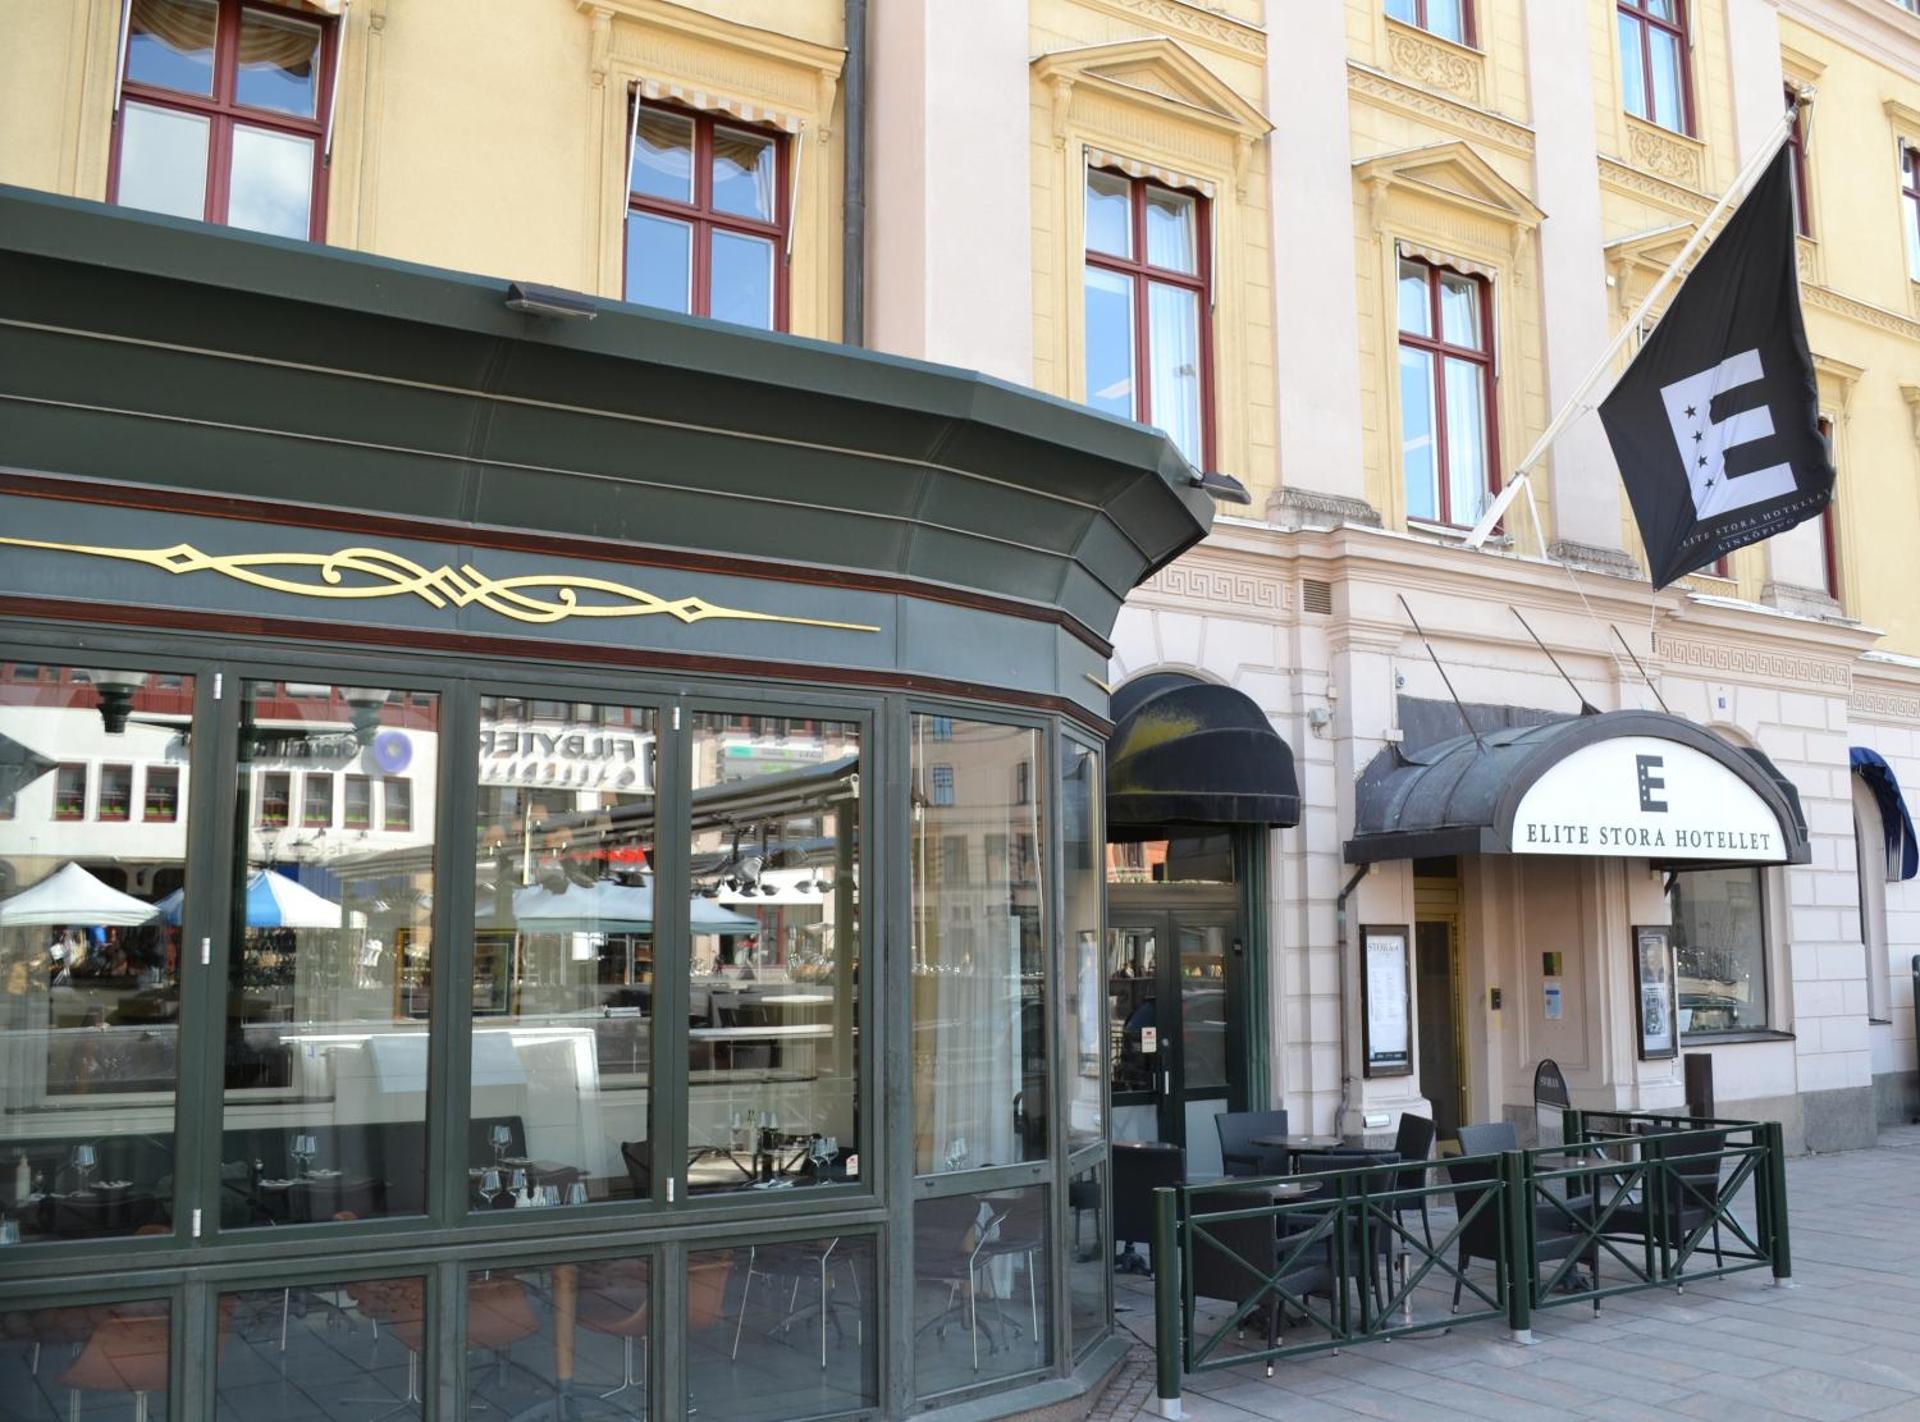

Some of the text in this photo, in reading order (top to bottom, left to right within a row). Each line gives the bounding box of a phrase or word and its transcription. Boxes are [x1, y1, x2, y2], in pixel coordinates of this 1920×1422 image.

[1660, 348, 1798, 521] E
[1680, 531, 1710, 549] LITE
[1715, 518, 1757, 535] STORA
[1636, 753, 1668, 812] E
[1527, 824, 1770, 850] ELITE STORA HOTELLET
